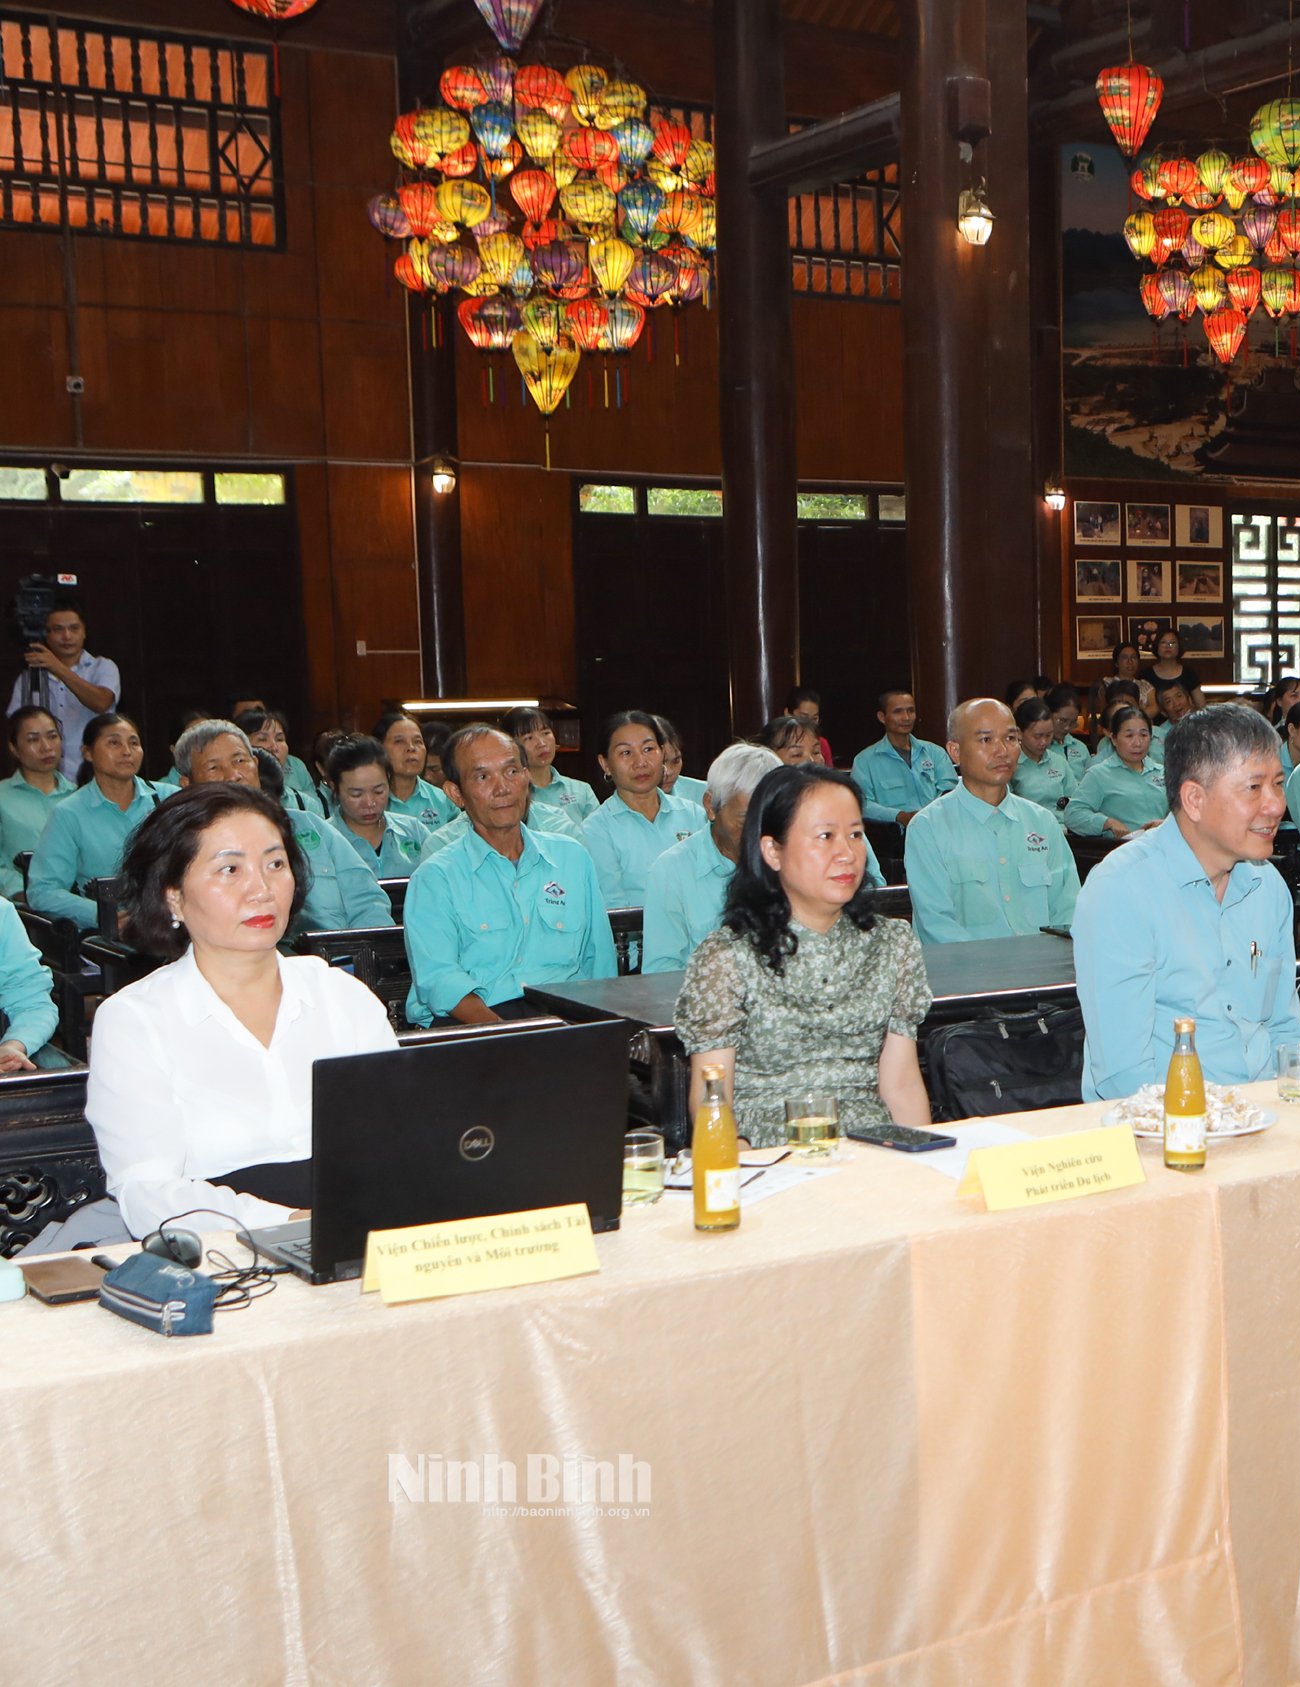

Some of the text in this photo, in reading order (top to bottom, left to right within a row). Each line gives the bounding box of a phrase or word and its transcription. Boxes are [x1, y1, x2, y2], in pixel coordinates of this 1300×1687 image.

[464, 1137, 491, 1150] DELL
[1022, 1153, 1103, 1178] Viện Nghiên cứu
[1025, 1171, 1111, 1198] Phát triển Du lịch
[376, 1243, 408, 1258] Viện
[411, 1233, 451, 1252] Chiến
[490, 1224, 530, 1240] Chính
[534, 1217, 562, 1233] sách
[564, 1214, 586, 1230] Tài
[415, 1240, 560, 1274] nguyên và Môi trường
